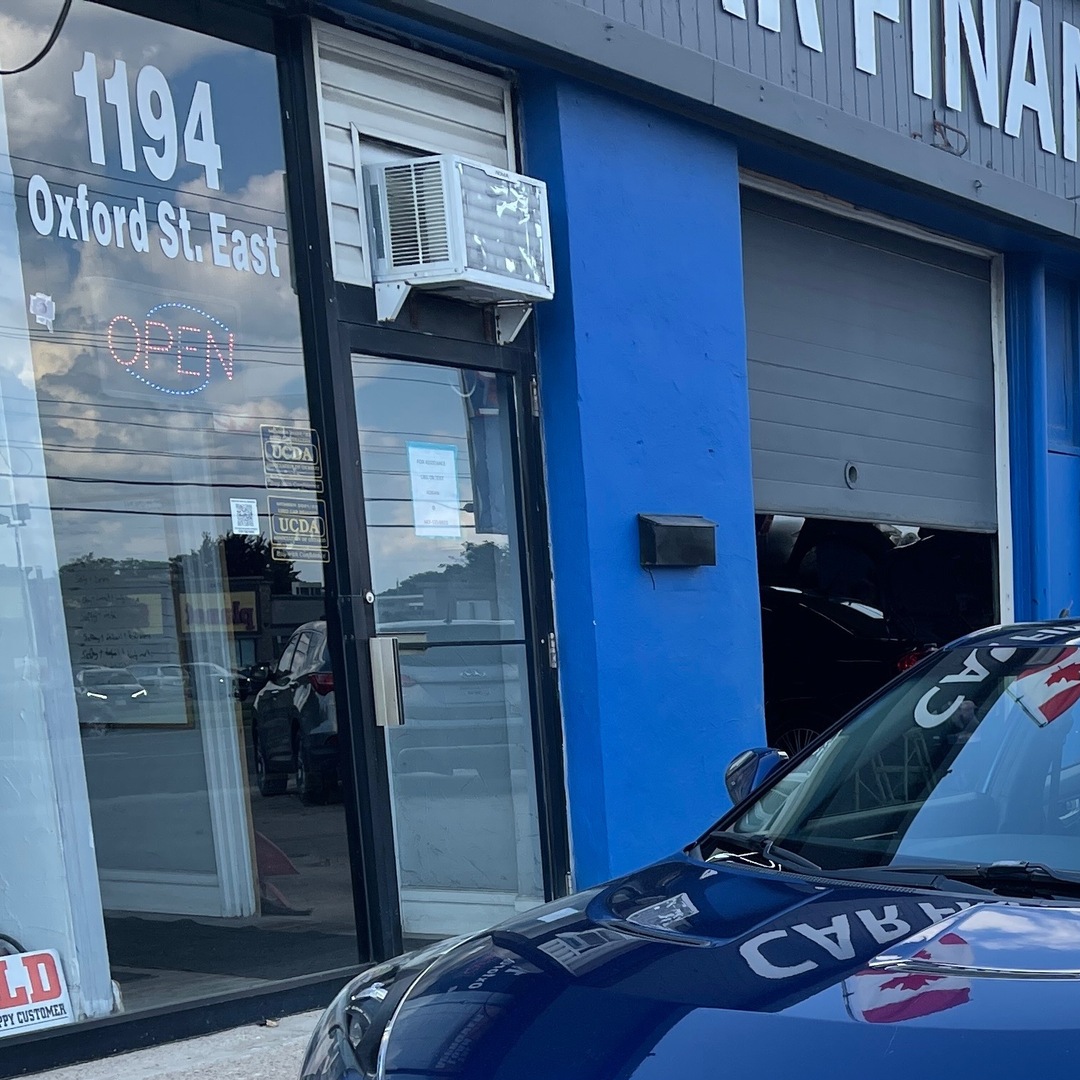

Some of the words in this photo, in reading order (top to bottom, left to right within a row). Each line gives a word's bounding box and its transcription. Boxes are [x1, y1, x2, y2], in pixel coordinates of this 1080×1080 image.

[72, 51, 223, 190] 1194
[27, 174, 149, 253] Oxford
[157, 200, 204, 263] St.
[209, 211, 280, 278] East
[107, 314, 234, 381] OPEN
[271, 444, 314, 462] UCDA
[278, 517, 321, 534] UCDA
[16, 1003, 67, 1024] CUSTOMER
